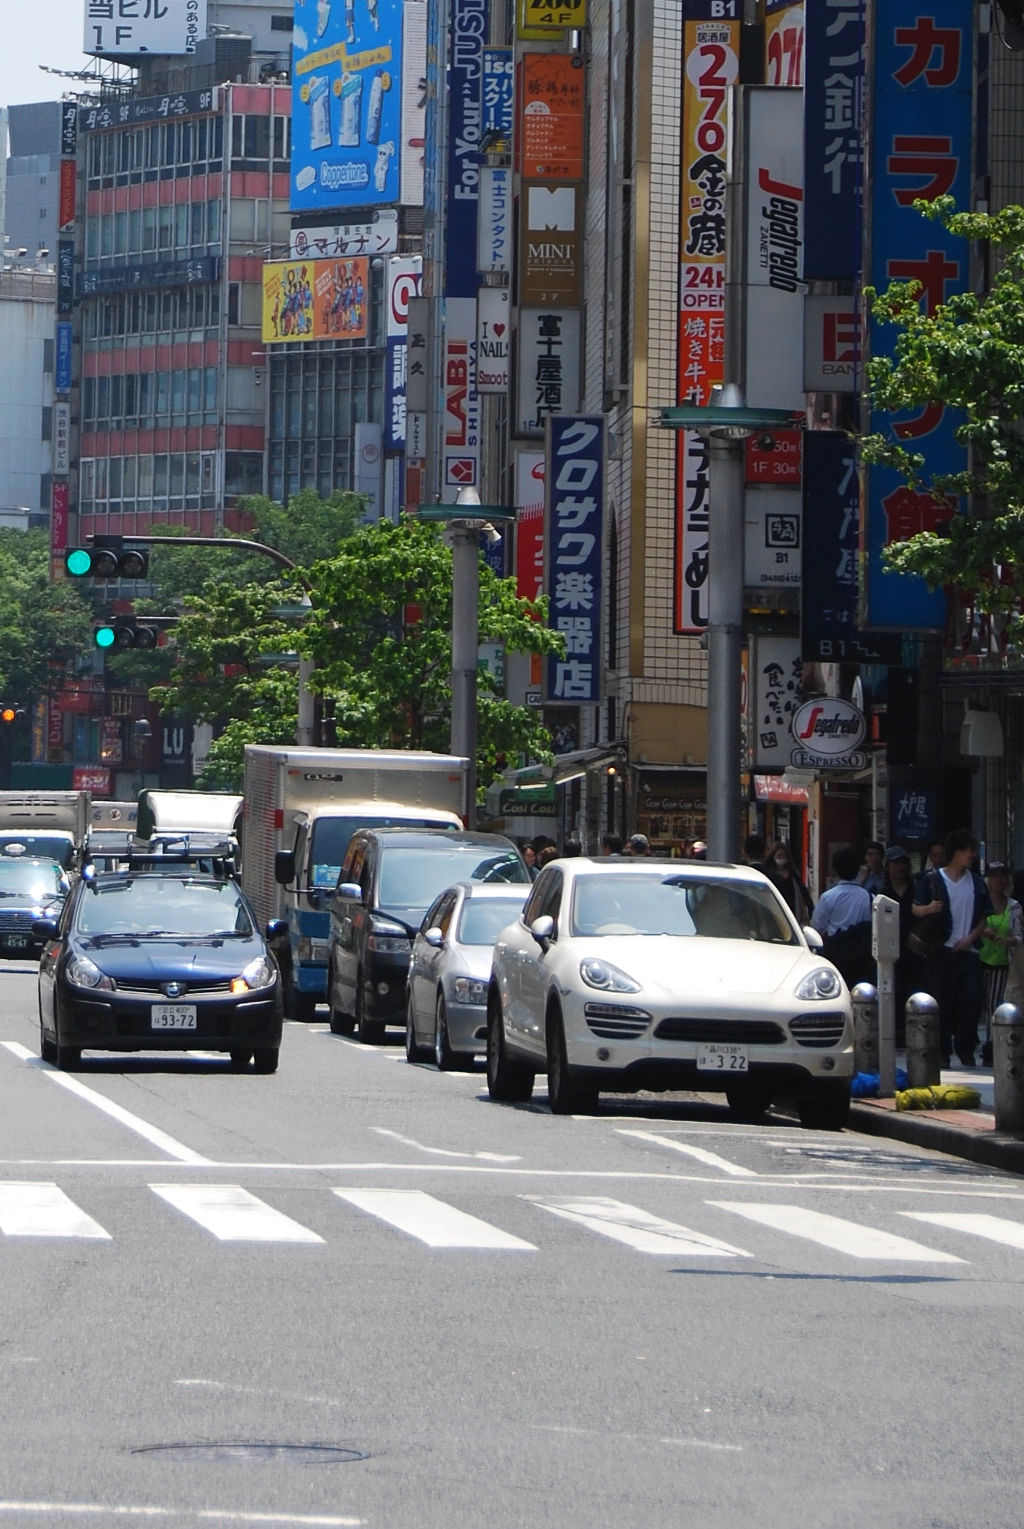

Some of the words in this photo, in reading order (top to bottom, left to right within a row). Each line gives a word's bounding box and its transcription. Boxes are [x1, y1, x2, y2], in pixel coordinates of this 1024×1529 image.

[539, 13, 572, 24] 4F
[711, 0, 737, 18] B1
[92, 26, 132, 46] 1F
[696, 31, 729, 43] 居酒屋
[200, 92, 211, 109] 9F
[698, 45, 728, 154] 270
[455, 90, 479, 156] Your
[455, 159, 479, 200] For
[493, 170, 505, 261] 富士コンタクト
[685, 154, 727, 257] 金の蔵
[314, 235, 391, 254] マルナン
[528, 244, 575, 258] MINT
[759, 226, 769, 269] ZANETTI
[822, 365, 860, 375] BAN
[446, 340, 468, 446] LABI
[57, 408, 67, 468] 渋谷駅前ビル
[554, 420, 600, 699] クロサワ楽器店
[820, 641, 845, 656] B1
[800, 708, 860, 739] Segafredo
[801, 754, 859, 766] ESPRESSO
[162, 1015, 195, 1026] 93-72
